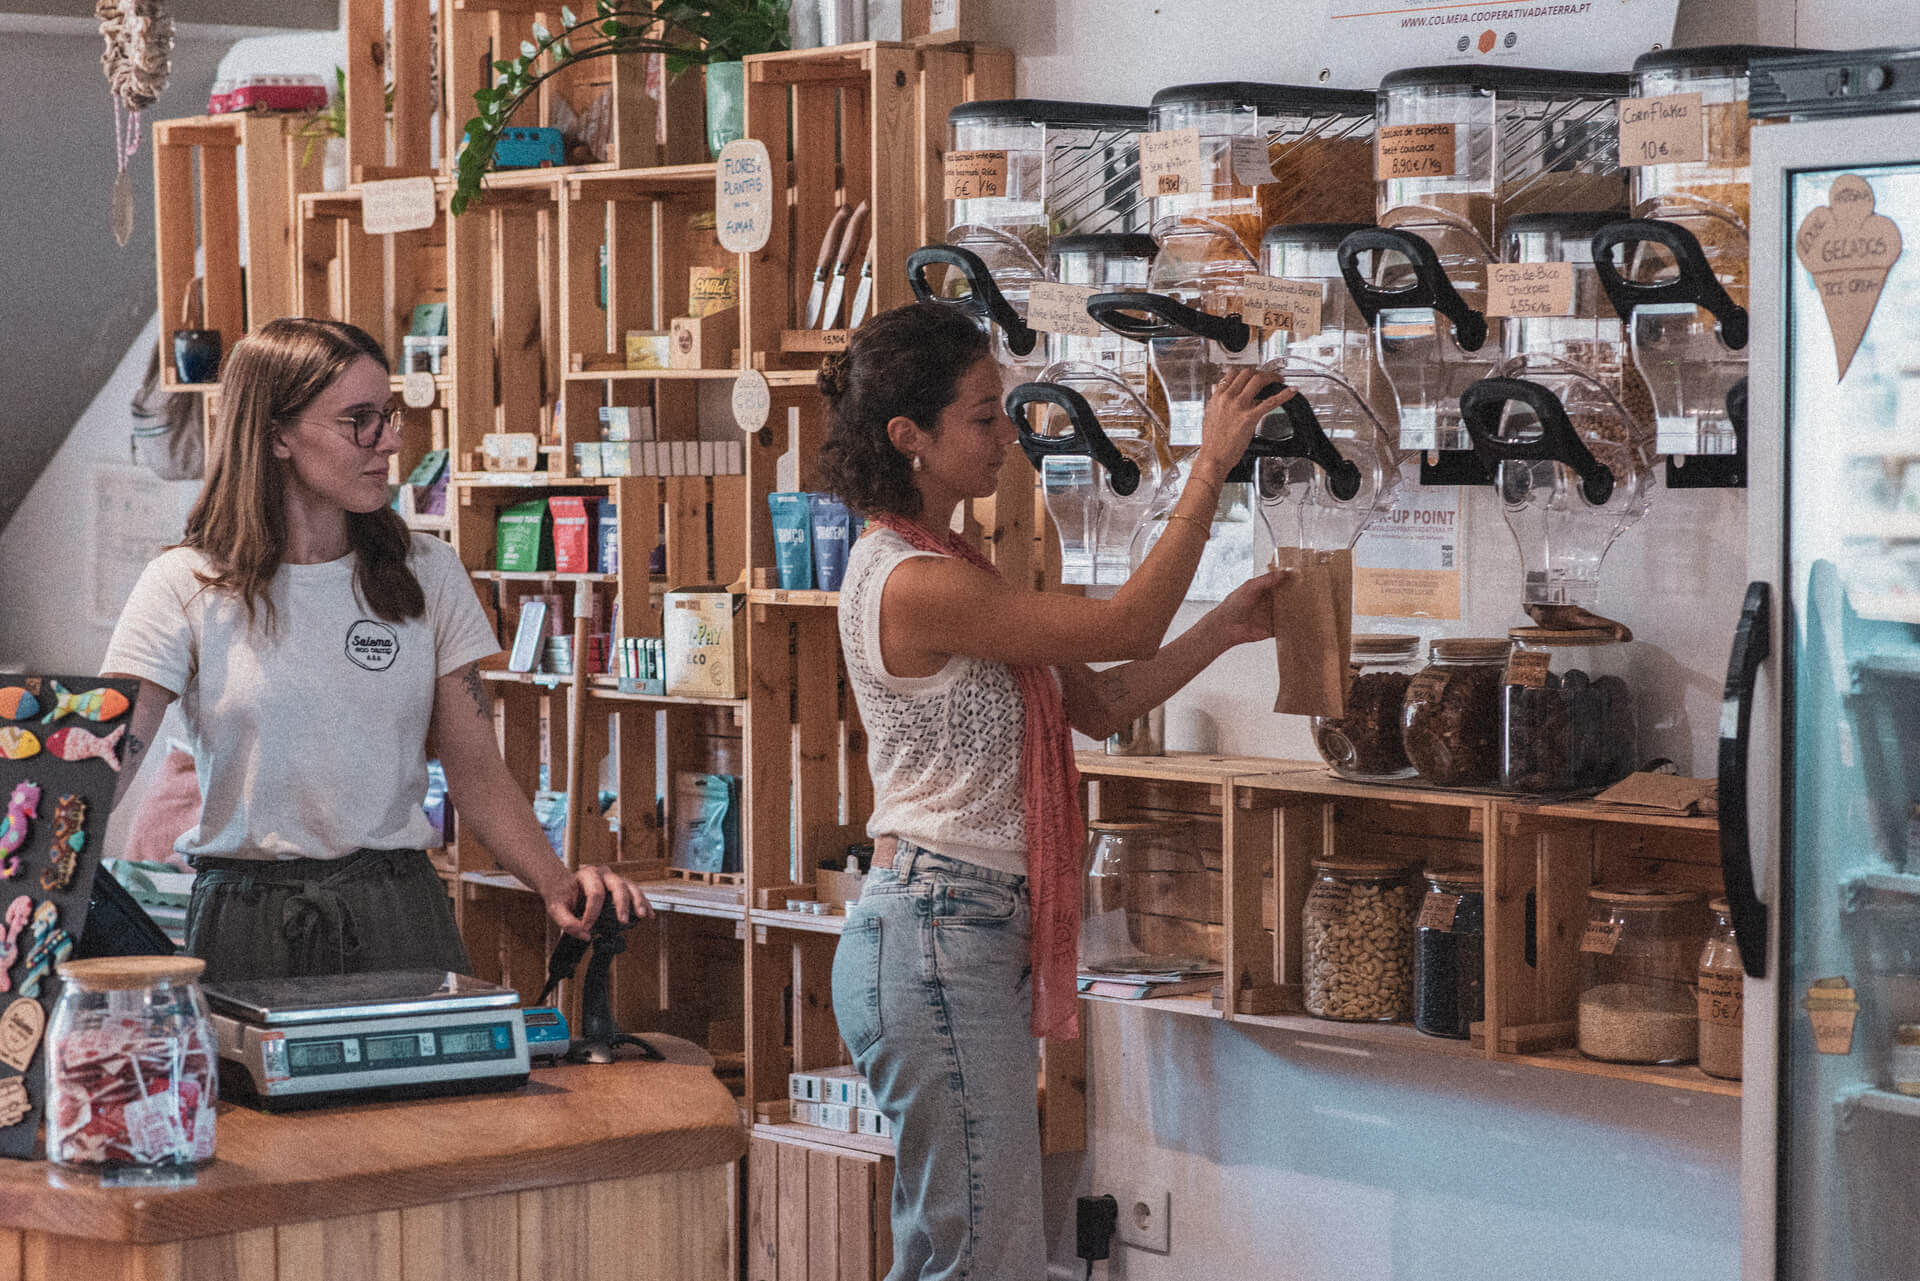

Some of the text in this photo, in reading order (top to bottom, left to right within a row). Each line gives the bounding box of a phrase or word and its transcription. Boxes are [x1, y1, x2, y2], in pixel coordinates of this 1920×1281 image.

[1400, 3, 1592, 28] WWW.COLMEIA.COOPERATIVADATERRA.PT
[724, 158, 755, 176] FLORES
[723, 178, 763, 195] PLANTAS
[726, 219, 755, 234] FUMAR
[696, 278, 730, 293] Wild
[1413, 510, 1456, 525] POINT
